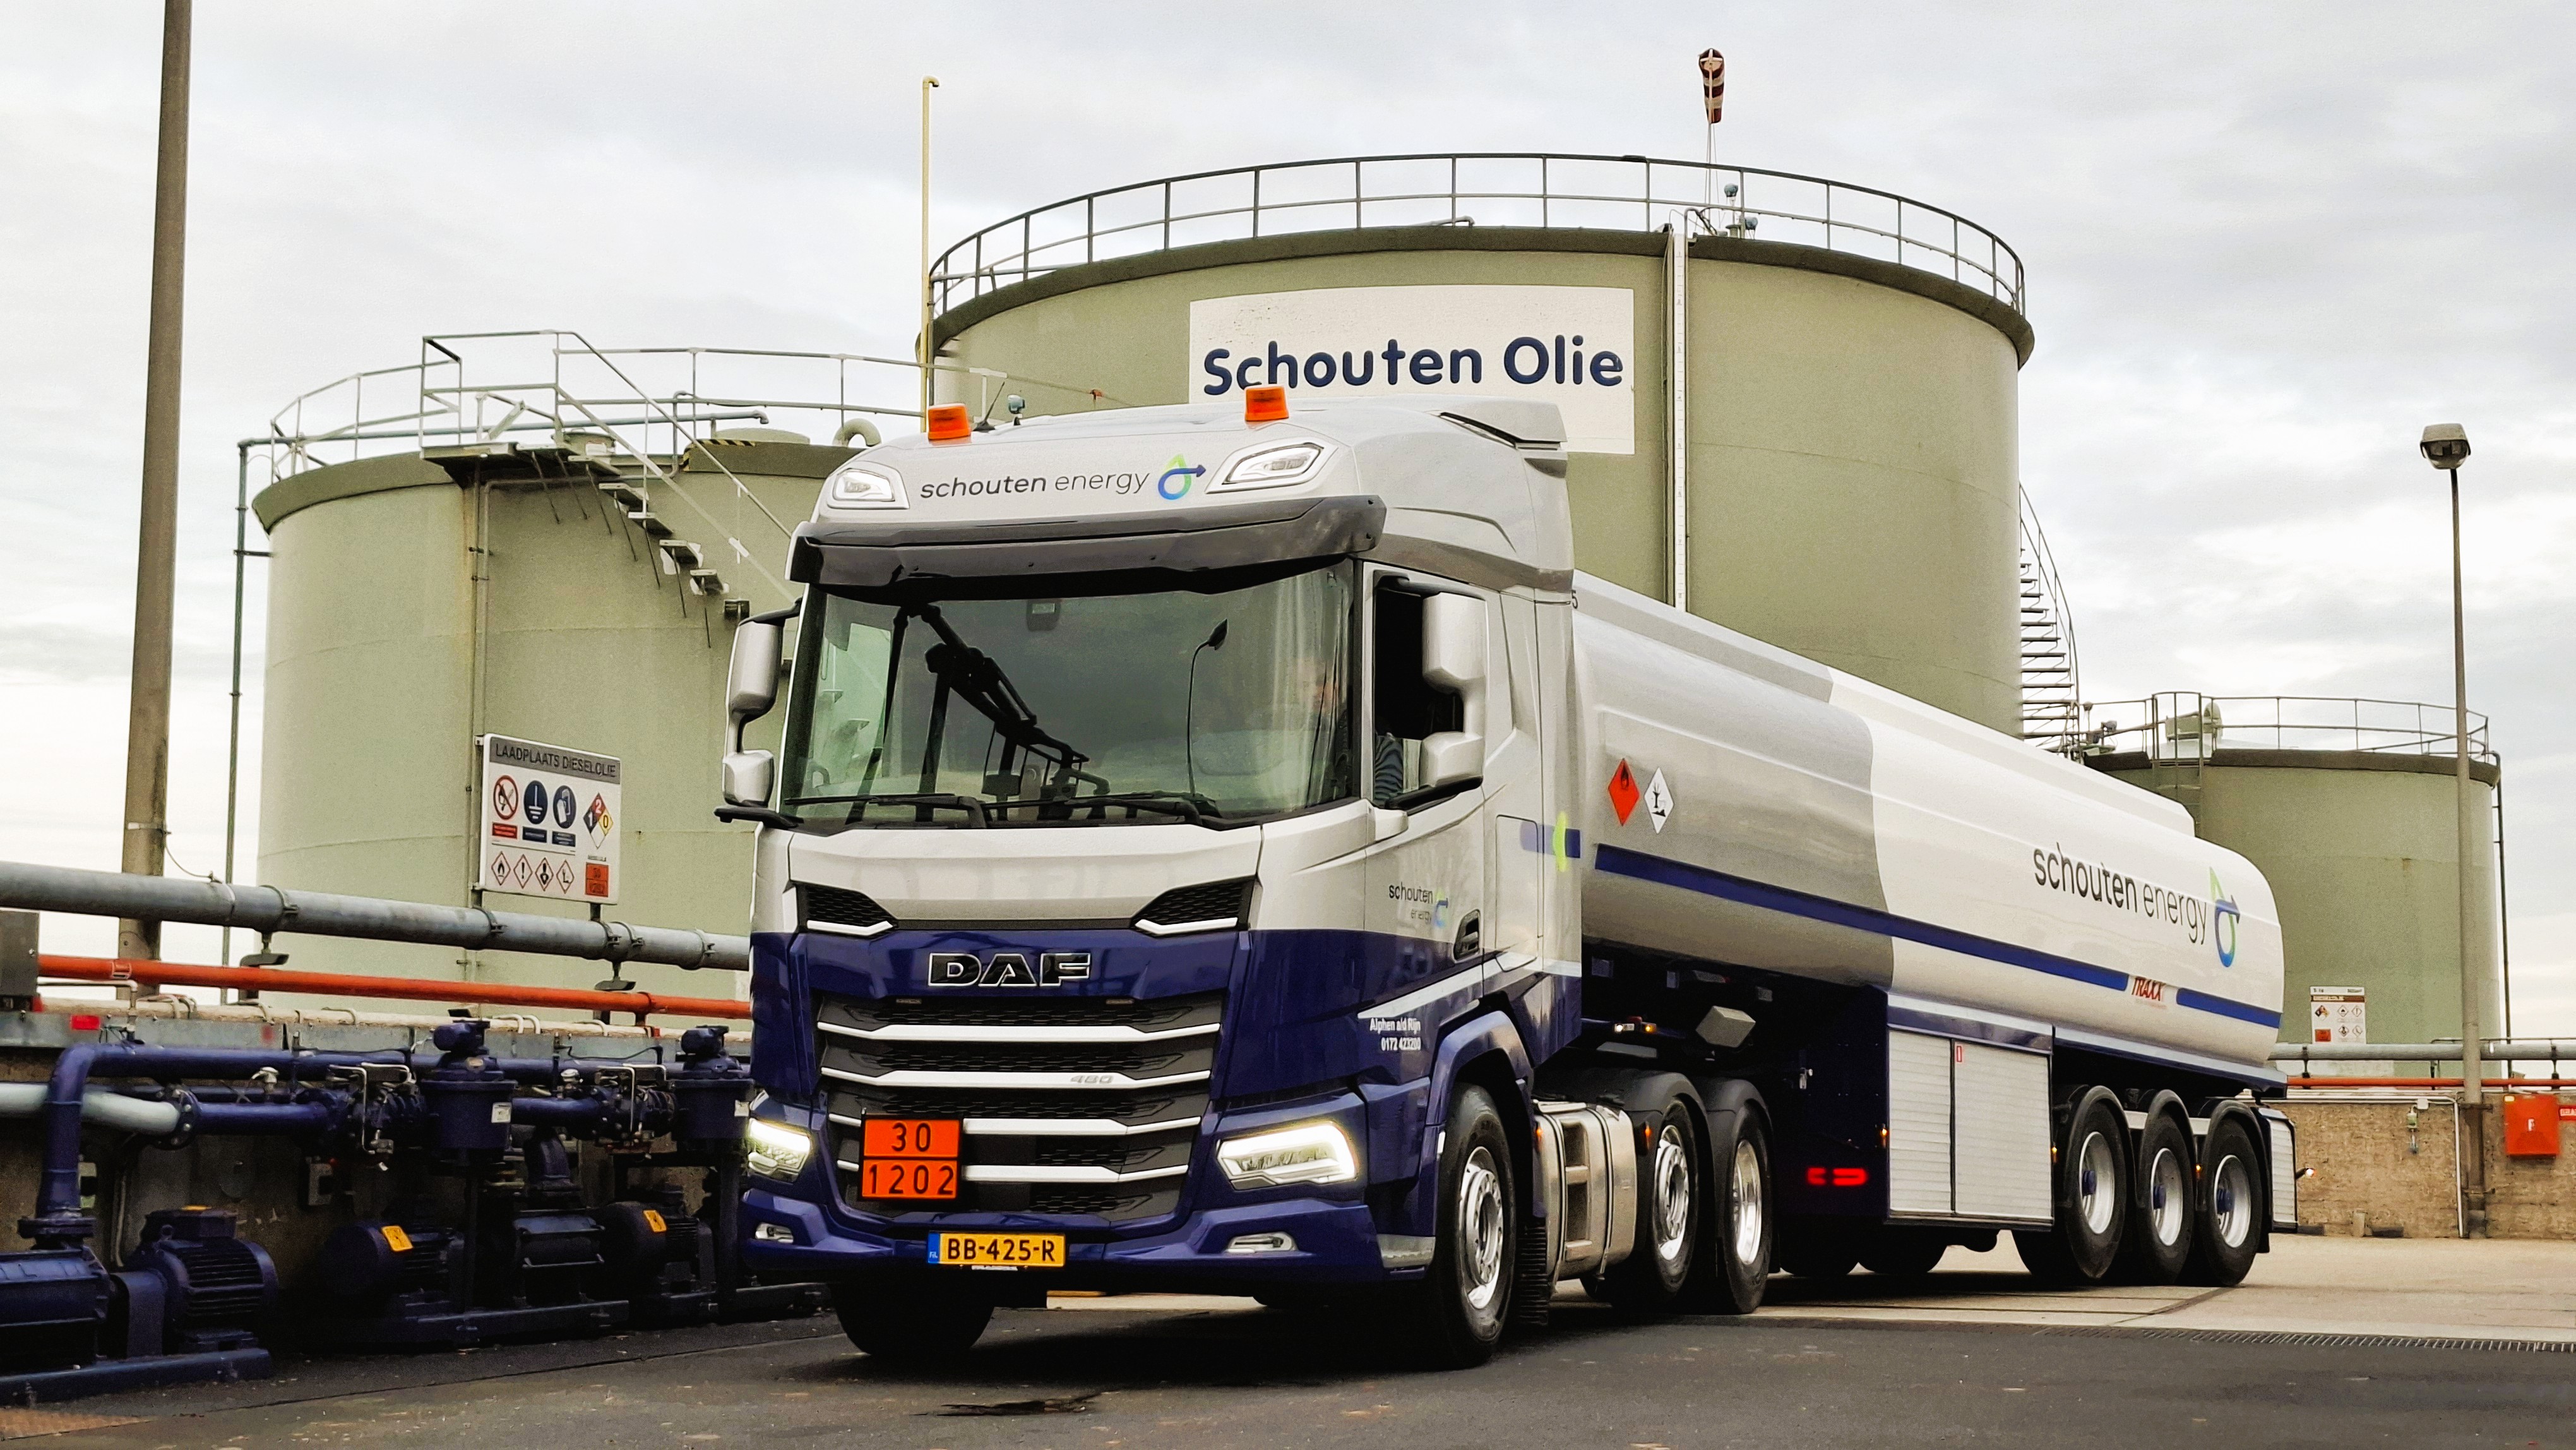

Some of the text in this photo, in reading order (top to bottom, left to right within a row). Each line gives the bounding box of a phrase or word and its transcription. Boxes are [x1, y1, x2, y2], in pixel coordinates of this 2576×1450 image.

[1203, 335, 1623, 395] Schouten Olie
[920, 472, 1150, 499] schouten energy
[496, 743, 559, 768] LAADPLAATS
[595, 799, 602, 814] 2
[588, 812, 593, 827] 1
[603, 815, 609, 829] 0
[1389, 882, 1433, 904] schouten
[2033, 842, 2207, 945] schouten energy
[928, 953, 1092, 987] DAF
[1369, 1017, 1395, 1034] Alphen
[1381, 1037, 1397, 1051] 0172
[891, 1122, 931, 1151] 30
[869, 1165, 955, 1195] 1202
[947, 1238, 1055, 1262] BB-425-R
